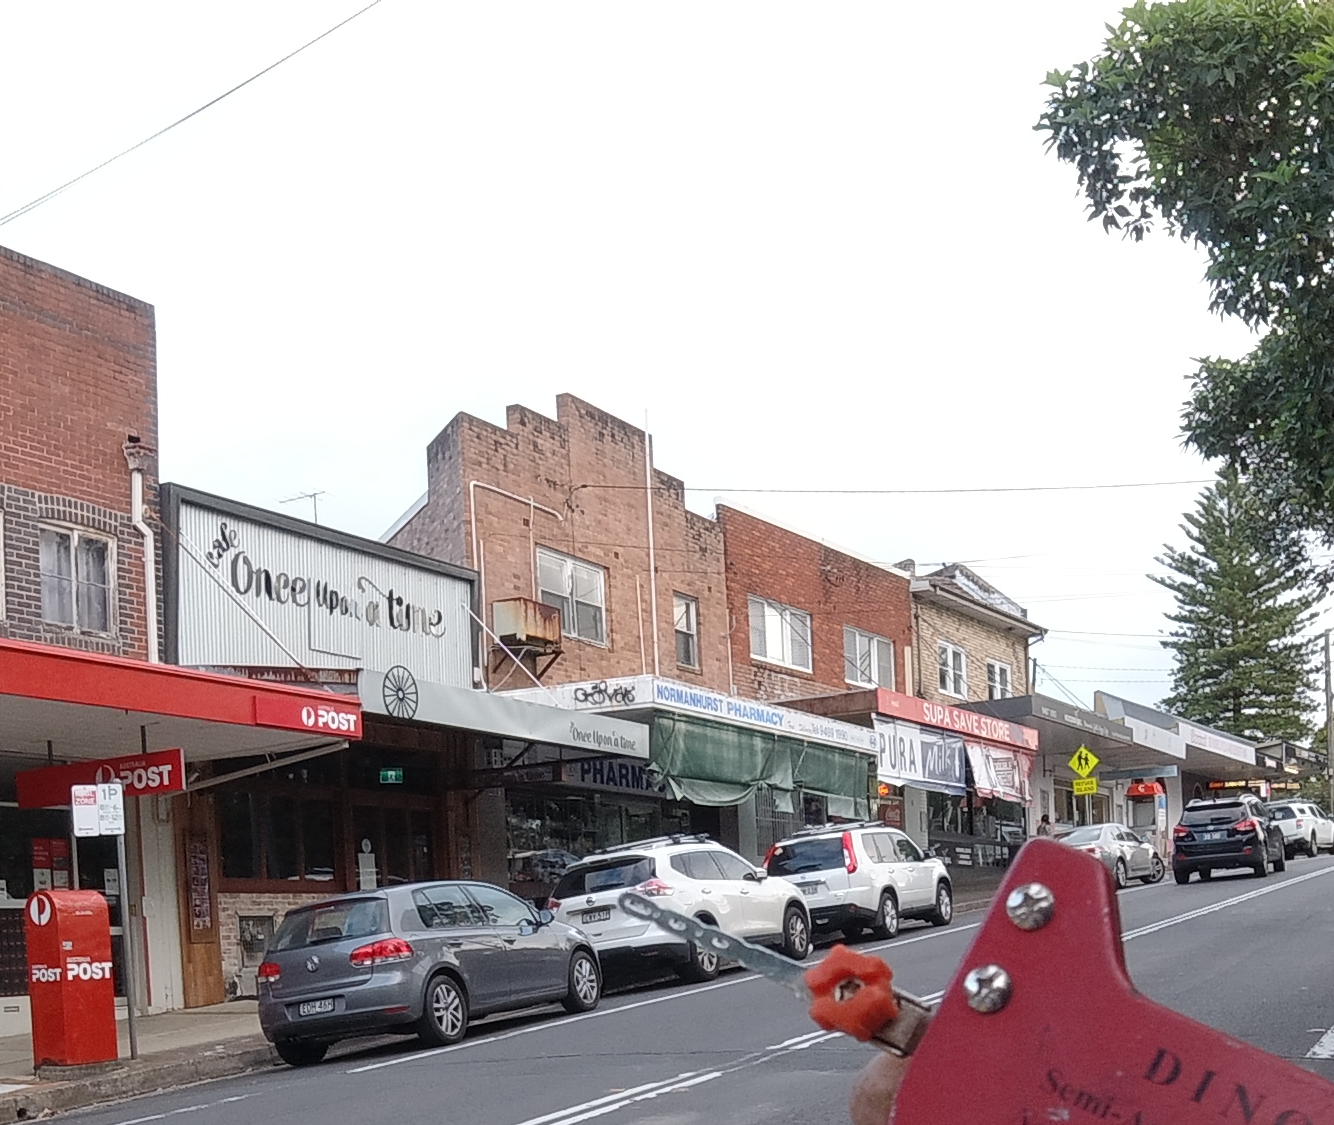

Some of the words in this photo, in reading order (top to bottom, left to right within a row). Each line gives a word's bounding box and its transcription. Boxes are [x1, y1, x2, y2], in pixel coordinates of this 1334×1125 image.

[231, 551, 309, 607] Once
[317, 709, 357, 731] POST
[656, 684, 724, 713] NORMANHURST
[727, 701, 785, 726] PHARMACY
[923, 702, 951, 727] SUPA
[953, 710, 980, 734] SAVE
[980, 717, 1011, 741] STORE
[878, 732, 918, 774] PURA
[121, 765, 172, 791] POST
[32, 967, 62, 983] POST
[67, 961, 113, 981] POST
